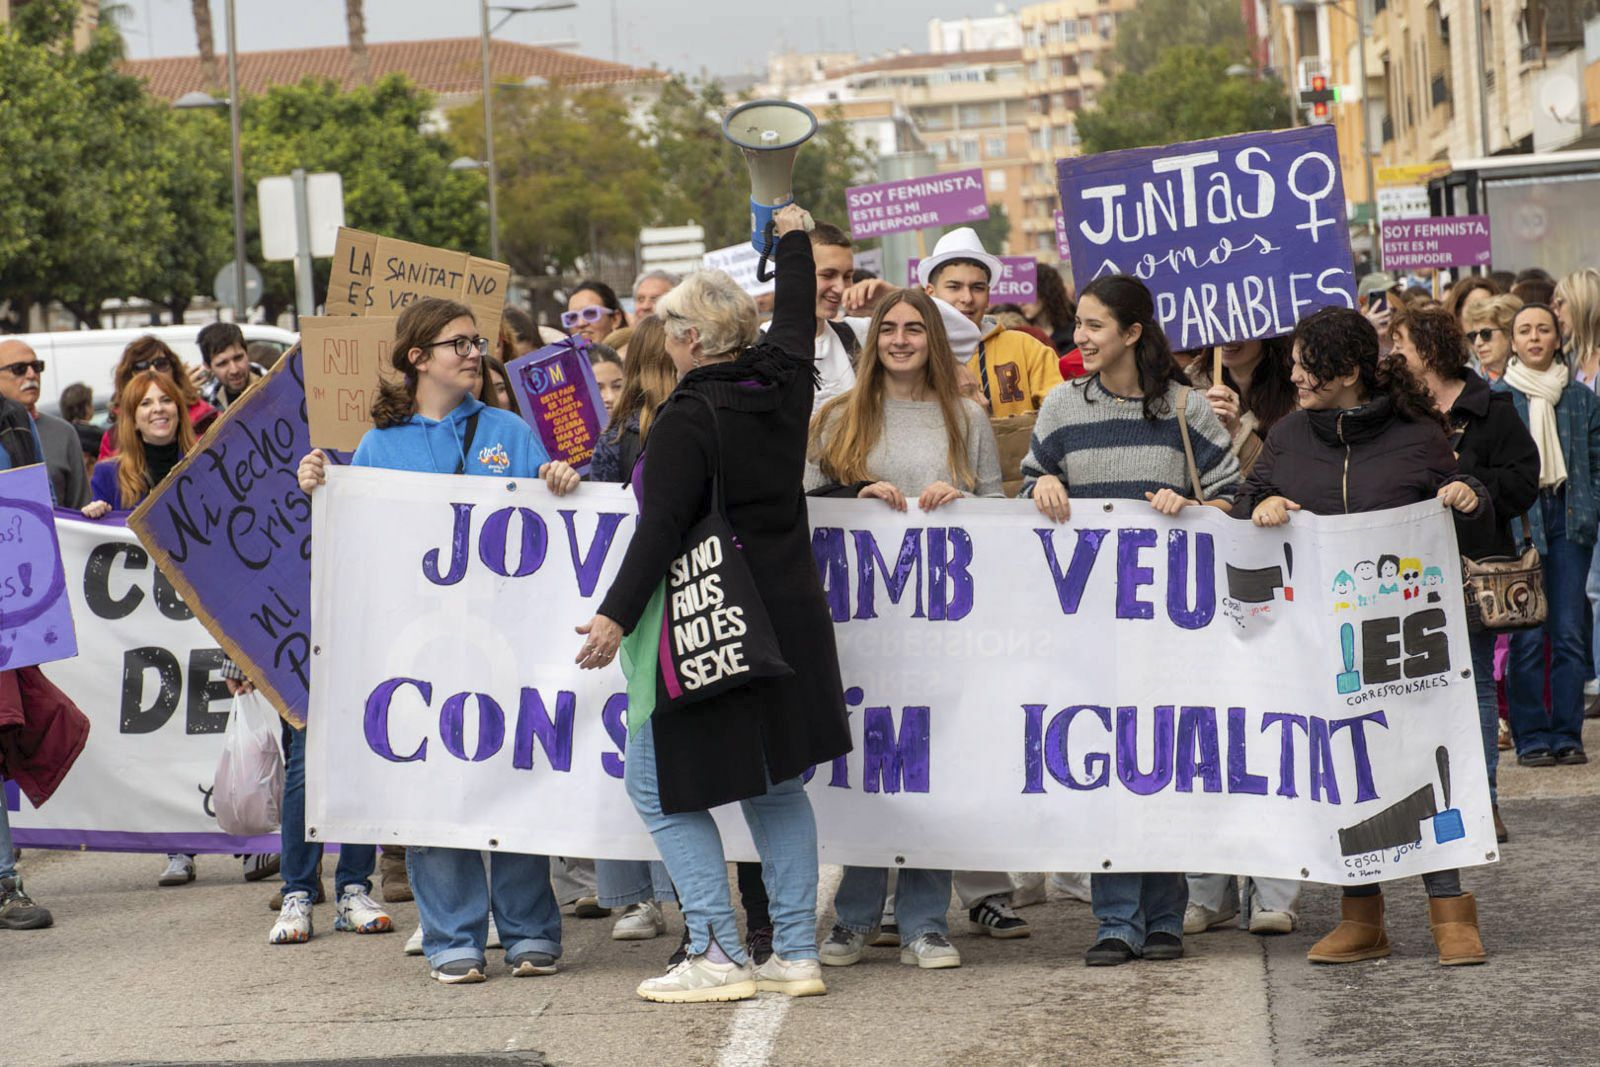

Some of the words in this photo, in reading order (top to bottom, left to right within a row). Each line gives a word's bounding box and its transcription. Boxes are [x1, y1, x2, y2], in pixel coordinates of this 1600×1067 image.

[850, 190, 884, 208] SOY
[887, 176, 982, 202] FEMINISTA,
[852, 206, 885, 222] ESTE
[886, 204, 903, 216] ES
[904, 201, 920, 213] MI
[853, 211, 940, 235] SUPERPODER
[1383, 225, 1411, 239] SOY
[1413, 221, 1489, 237] FEMINISTA,
[1384, 241, 1410, 253] ESTE
[1411, 240, 1425, 252] ES
[1426, 240, 1439, 251] MI
[1384, 252, 1453, 266] SUPERPODER
[348, 245, 372, 277] LA
[466, 273, 498, 296] NO
[348, 281, 375, 307] ES
[1156, 267, 1355, 348] PARABLES
[323, 338, 360, 376] NI
[540, 391, 559, 405] ESTE
[543, 400, 584, 421] MACHISTA
[557, 394, 574, 407] TAN
[552, 415, 569, 426] QUE
[552, 418, 585, 435] CELEBRA
[573, 425, 586, 436] UN
[557, 440, 574, 452] GOL
[573, 432, 591, 445] QUE
[567, 444, 586, 456] UNA
[202, 417, 295, 504] techo
[226, 490, 312, 570] Cris
[669, 553, 690, 587] SI
[690, 535, 724, 578] NO
[1031, 527, 1217, 630] VEU
[671, 573, 725, 621] RIUS
[673, 615, 711, 656] NO
[679, 641, 751, 691] SEXE
[1346, 674, 1449, 706] CORRESPONSALES
[1019, 704, 1389, 805] IGUALTAT
[1344, 848, 1385, 869] casal
[1392, 839, 1422, 863] jove
